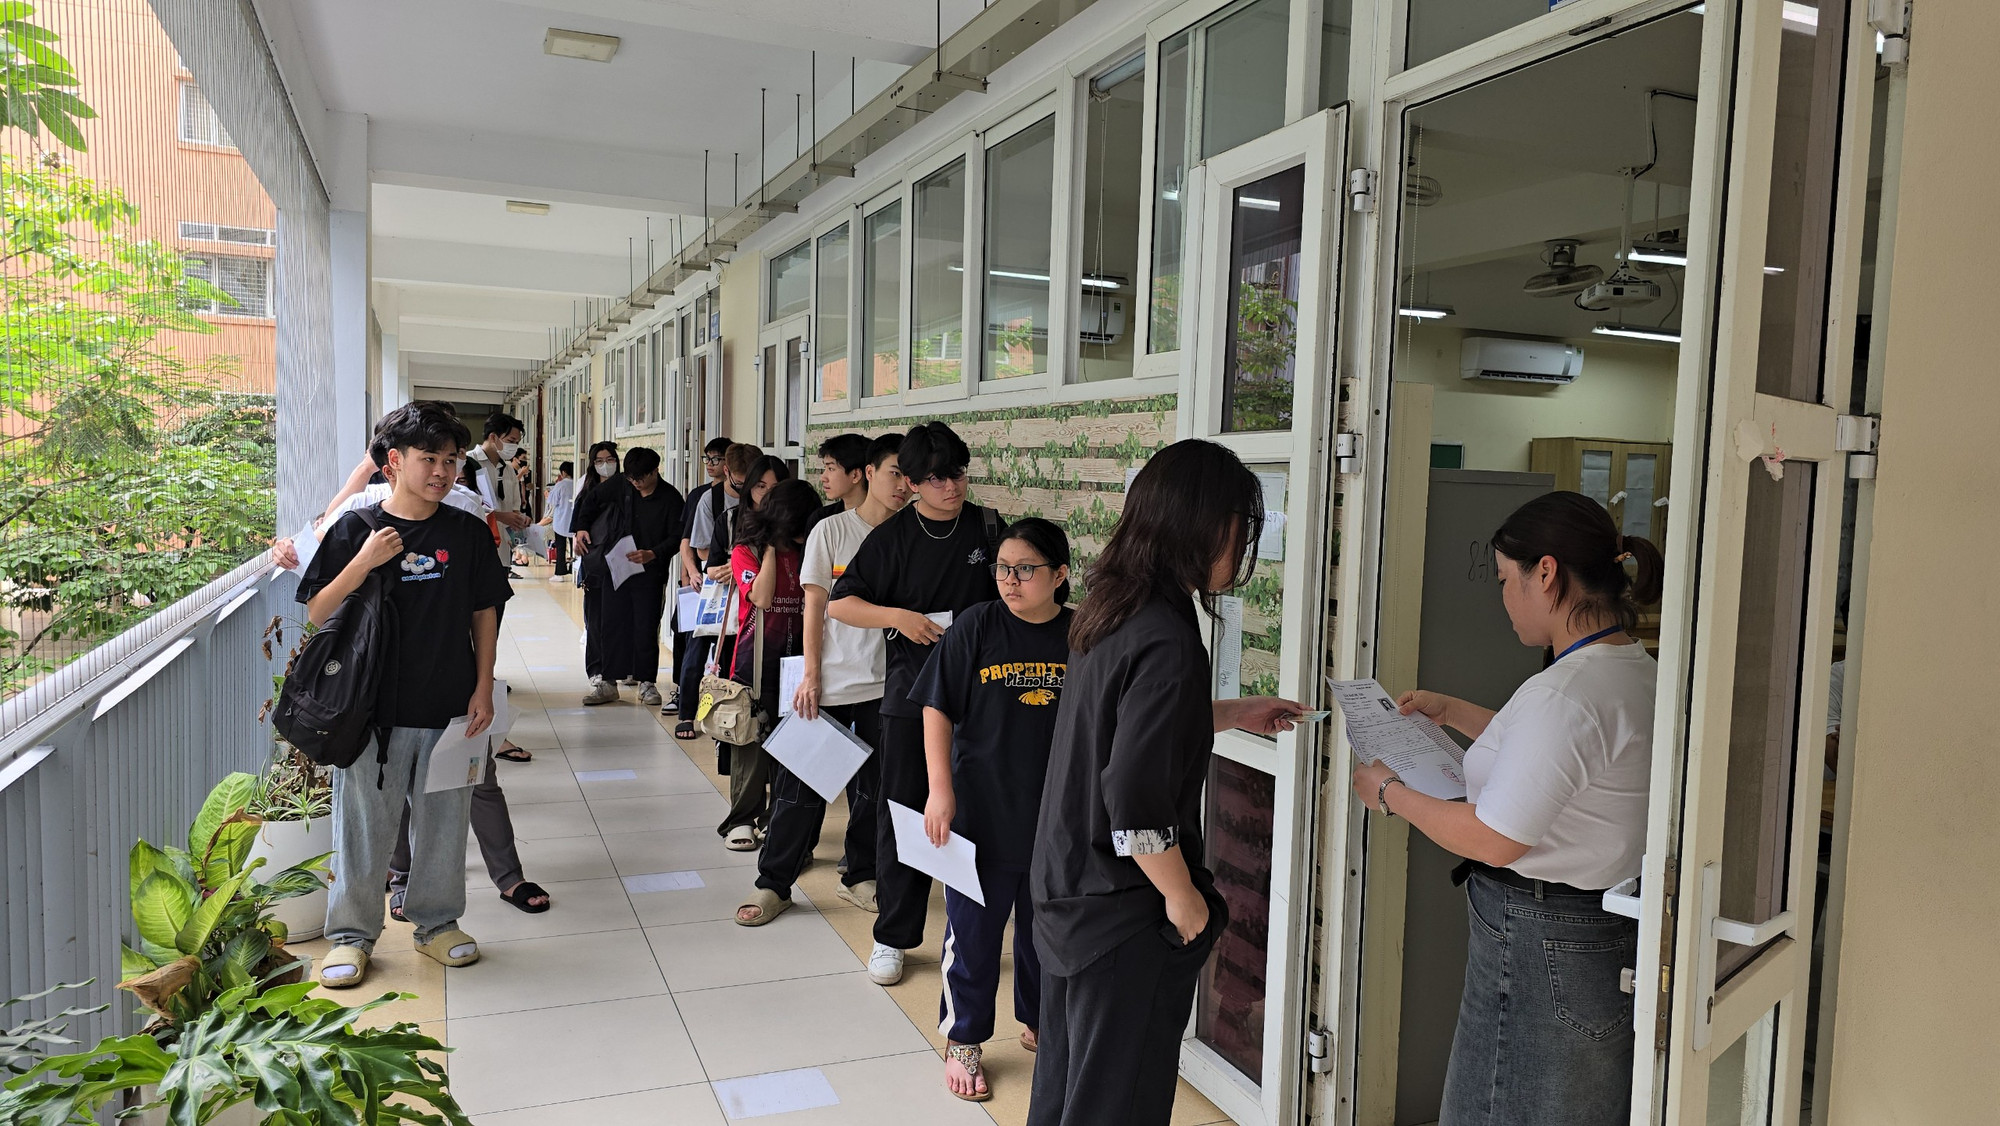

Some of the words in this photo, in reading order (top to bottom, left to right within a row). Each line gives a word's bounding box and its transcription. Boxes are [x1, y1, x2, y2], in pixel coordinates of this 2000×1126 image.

[771, 596, 800, 605] tandard
[764, 605, 799, 614] Chartered
[979, 662, 1067, 685] PROPERTY
[1005, 672, 1041, 687] Plano
[1042, 672, 1064, 688] Eas
